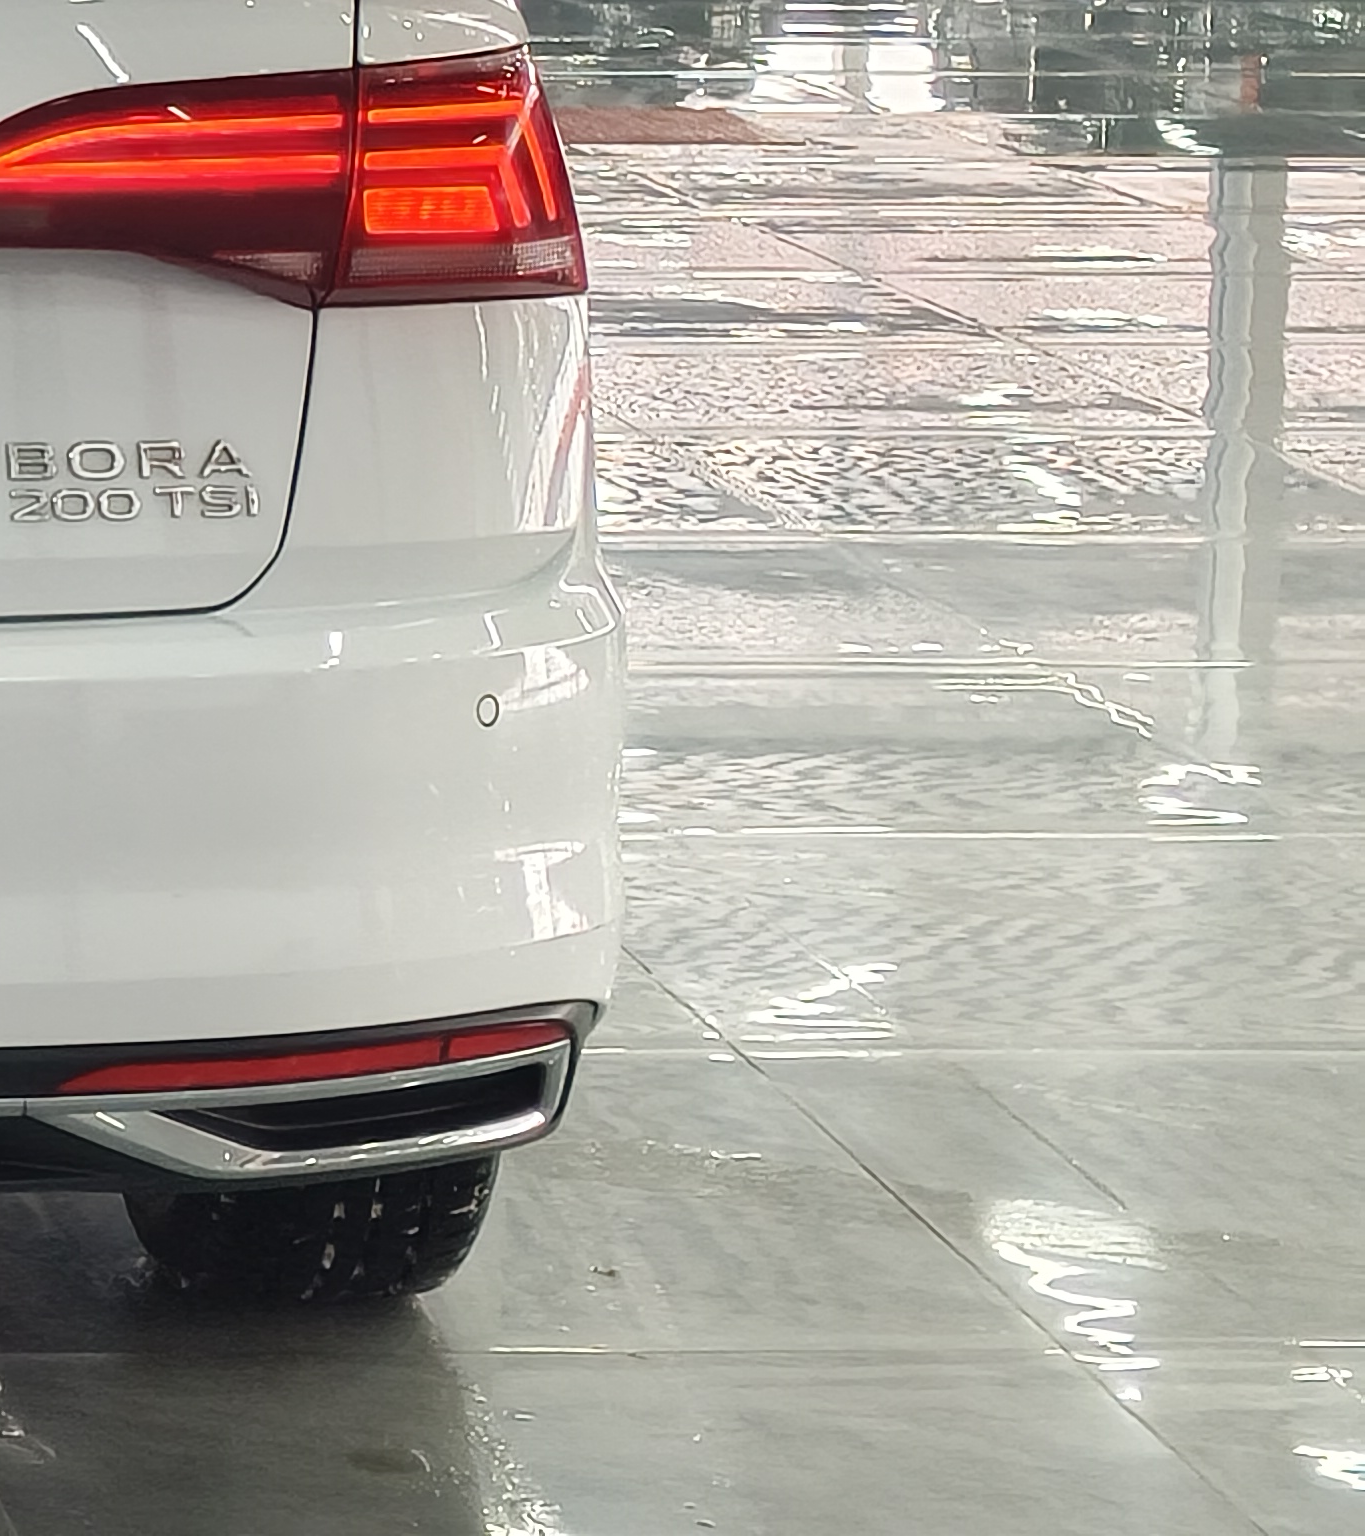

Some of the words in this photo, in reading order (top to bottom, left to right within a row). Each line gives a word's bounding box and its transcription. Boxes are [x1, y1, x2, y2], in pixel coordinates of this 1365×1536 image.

[5, 439, 253, 481] BORA
[8, 487, 142, 524] 200
[152, 483, 261, 520] TSI
